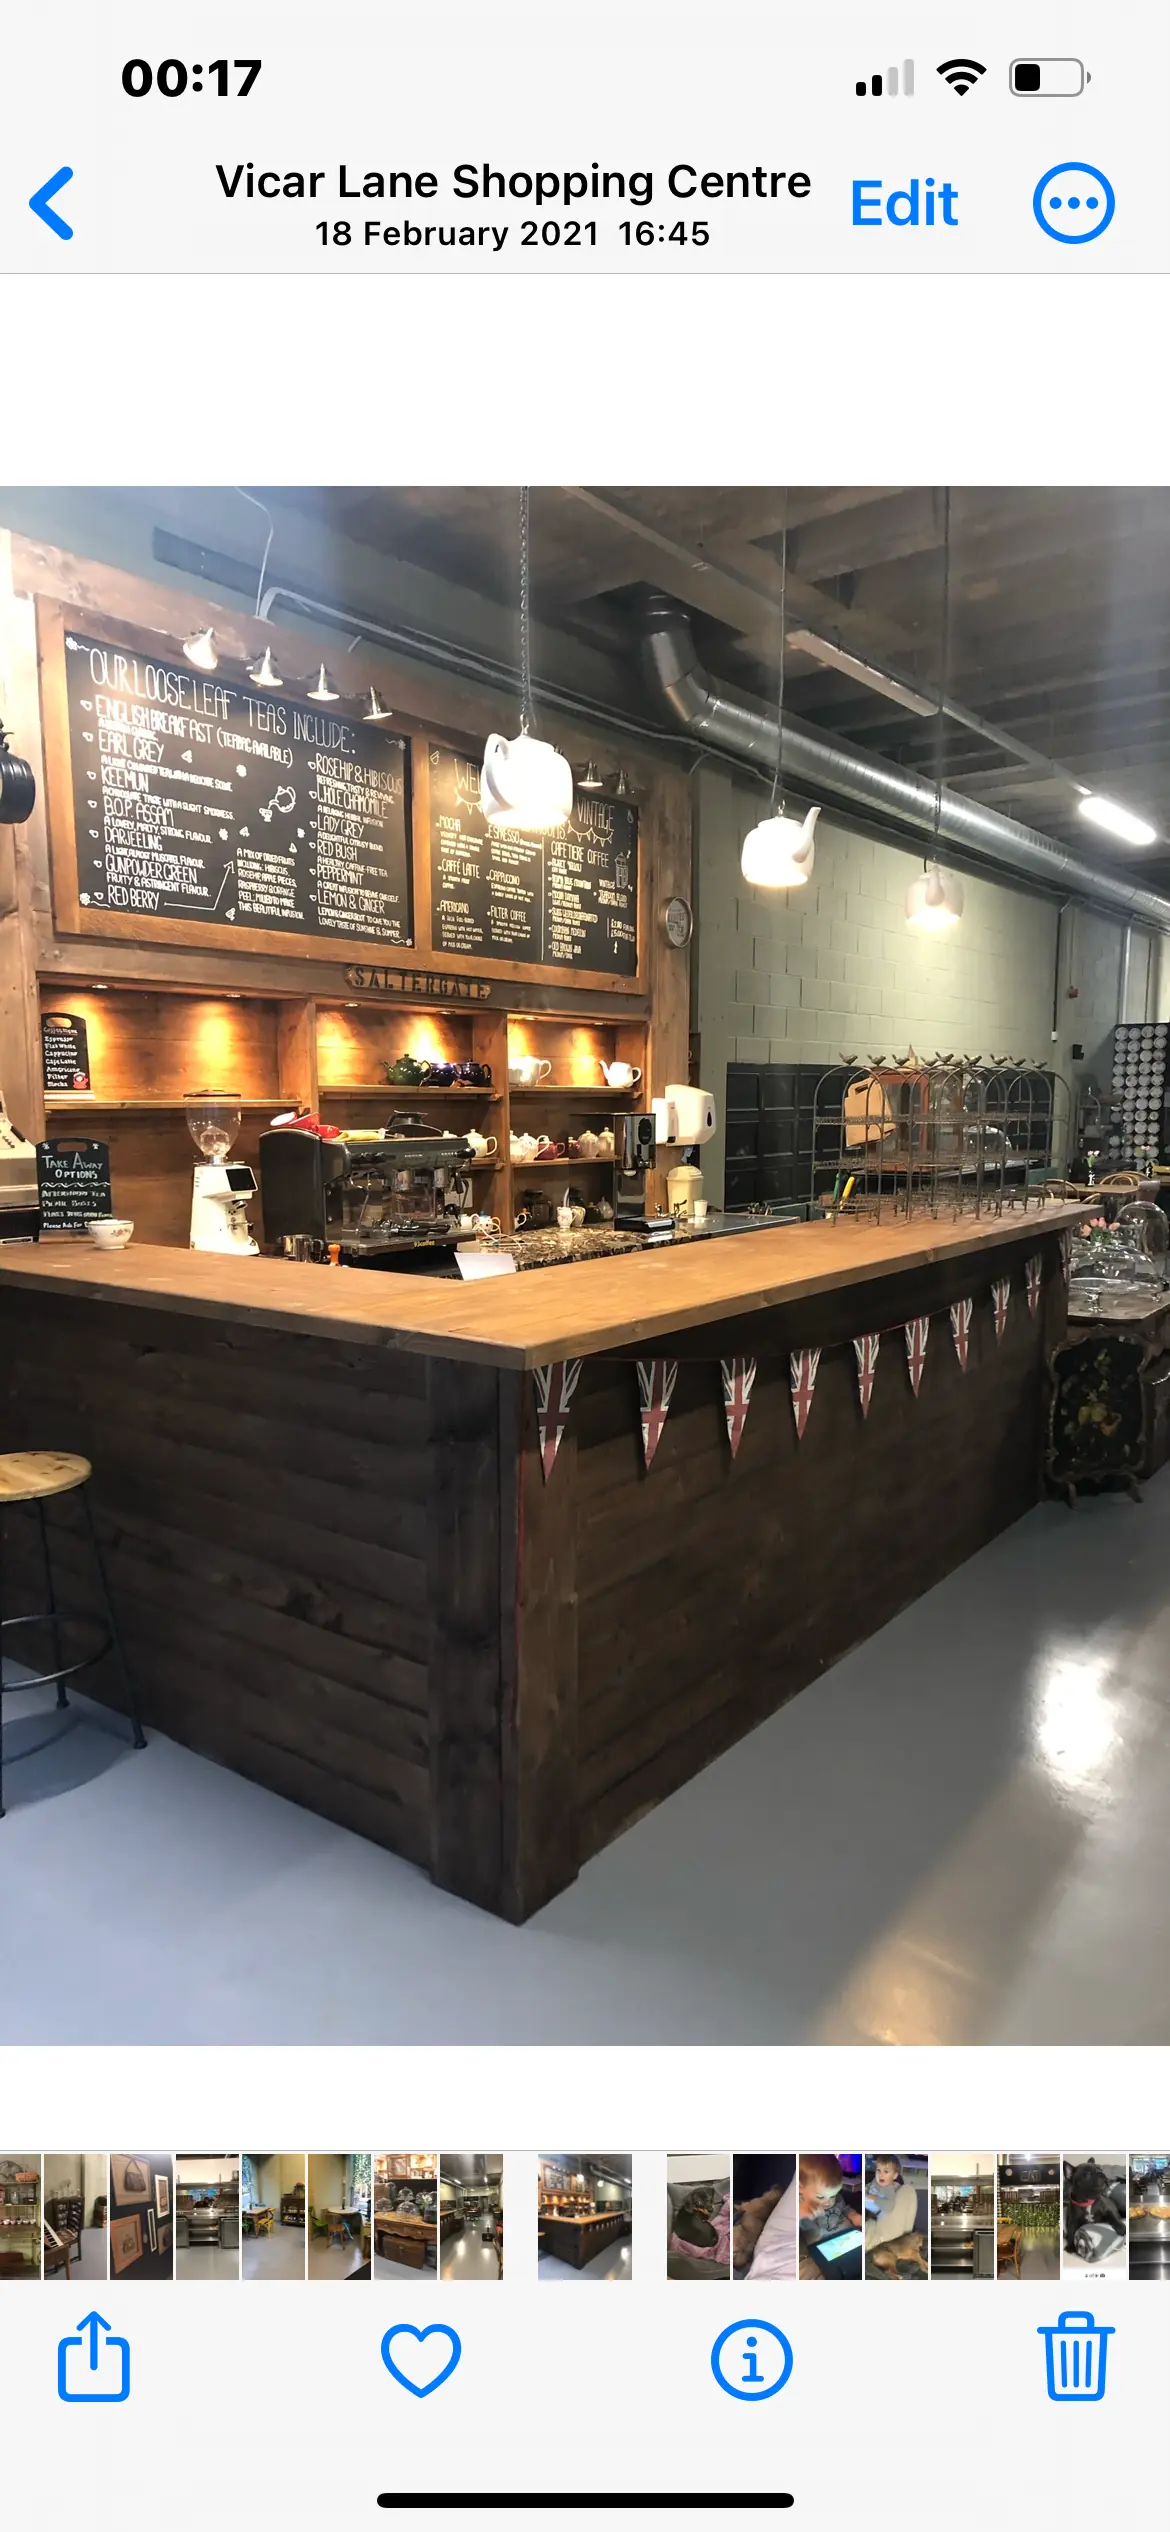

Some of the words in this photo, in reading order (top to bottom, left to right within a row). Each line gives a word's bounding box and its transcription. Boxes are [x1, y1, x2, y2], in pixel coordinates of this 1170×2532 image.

[90, 647, 133, 695] OUR
[132, 659, 192, 711] LOOSE
[193, 679, 237, 720] LEAF
[243, 696, 287, 736] TEAS
[293, 711, 356, 754] INCLUDE:
[95, 694, 149, 730] ENGLISH
[150, 708, 213, 744] BREAKFAST
[252, 737, 293, 768] AVAILABLE)
[98, 728, 132, 758] EARL
[133, 738, 164, 763] GREY
[316, 752, 353, 781] ROSEHIP
[354, 765, 364, 783] &
[101, 765, 149, 793] KEEMUN
[348, 783, 364, 795] TASTY
[317, 780, 343, 807] WHOLE
[343, 791, 388, 819] CHAMOMILE
[317, 804, 322, 813] A
[103, 796, 134, 818] B.O.P.
[136, 803, 174, 826] ASSAM
[577, 796, 615, 834] VINTAGE
[104, 815, 110, 826] A
[160, 825, 184, 839] STRONG
[317, 813, 340, 833] LADY
[340, 819, 364, 838] GREY
[439, 814, 461, 833] MOCHA
[104, 826, 163, 852] DARJEELING
[488, 824, 520, 844] ESPRESSO
[105, 844, 111, 853] A
[236, 847, 242, 857] A
[243, 848, 254, 859] MIX
[254, 852, 262, 860] OF
[317, 839, 333, 856] RED
[335, 842, 357, 861] BUSH
[551, 840, 584, 863] CAFETIERE
[587, 848, 609, 868] COFFEE
[105, 853, 163, 880] GUNPOWDER
[163, 864, 198, 884] GREEN
[317, 855, 322, 863] A
[261, 873, 277, 883] APPLE
[317, 863, 364, 886] PEPPERMINT
[462, 862, 480, 879] LATTE
[489, 869, 520, 885] CAPPUCCINO
[106, 872, 134, 886] FRUITY
[134, 877, 141, 887] &
[141, 878, 180, 892] ASTRINGENT
[238, 879, 268, 893] RASPBERRY
[268, 885, 274, 893] &
[274, 886, 296, 898] ORANGE
[317, 880, 322, 888] A
[323, 881, 338, 891] GREAT
[107, 884, 129, 905] RED
[130, 888, 159, 910] BERRY
[272, 896, 279, 905] TO
[280, 898, 296, 908] MAKE
[317, 888, 347, 908] LEMON
[348, 894, 357, 910] &
[359, 896, 385, 914] GINGER
[440, 900, 469, 914] AMERICANO
[238, 901, 252, 911] THIS
[252, 902, 281, 916] BEAUTIFUL
[490, 905, 509, 919] FILTER
[510, 910, 526, 923] COFFEE
[318, 916, 337, 927] LOVELY
[337, 921, 349, 930] TASTE
[367, 915, 373, 924] TO
[383, 918, 391, 926] YOU
[355, 967, 486, 999] SALTERGATE
